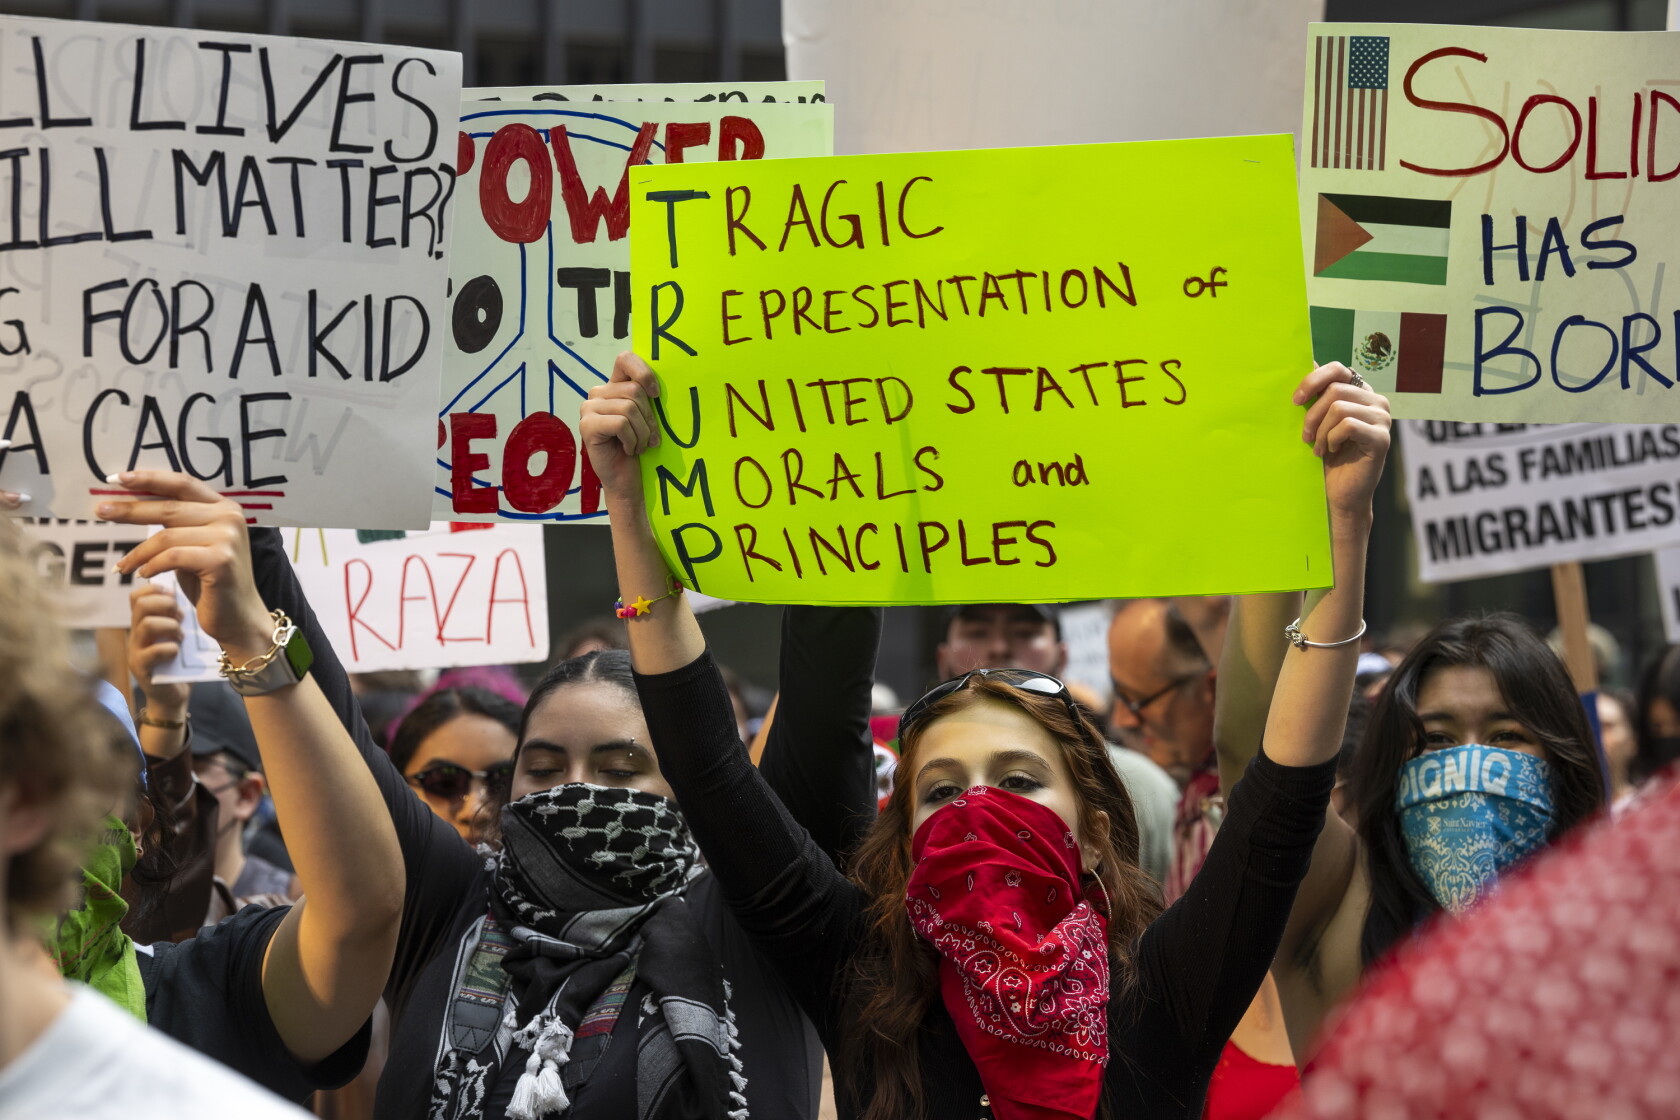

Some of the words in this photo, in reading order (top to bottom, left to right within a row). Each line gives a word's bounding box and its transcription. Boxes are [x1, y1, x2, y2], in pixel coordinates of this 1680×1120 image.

[130, 38, 439, 163] LIVES
[1399, 46, 1680, 182] SOLID
[172, 150, 457, 260] MATTER?
[645, 176, 944, 269] TRAGIC
[1481, 214, 1637, 286] HAS
[83, 278, 213, 374] FOR
[228, 282, 282, 380] A
[308, 288, 430, 382] KID
[446, 274, 503, 354] O
[651, 262, 1138, 361] REPRESENTATION
[1183, 266, 1228, 298] of
[1473, 305, 1680, 397] BOR
[0, 390, 50, 475] A
[83, 388, 292, 489] CAGE
[654, 376, 914, 449] UNITED
[947, 359, 1187, 414] STATES
[656, 446, 944, 517] MORALS
[1012, 453, 1090, 488] and
[1417, 463, 1438, 499] A
[1444, 453, 1509, 493] LAS
[1516, 425, 1680, 482] FAMILIAS
[670, 518, 1057, 592] PRINCIPLES
[344, 548, 535, 662] RAZA
